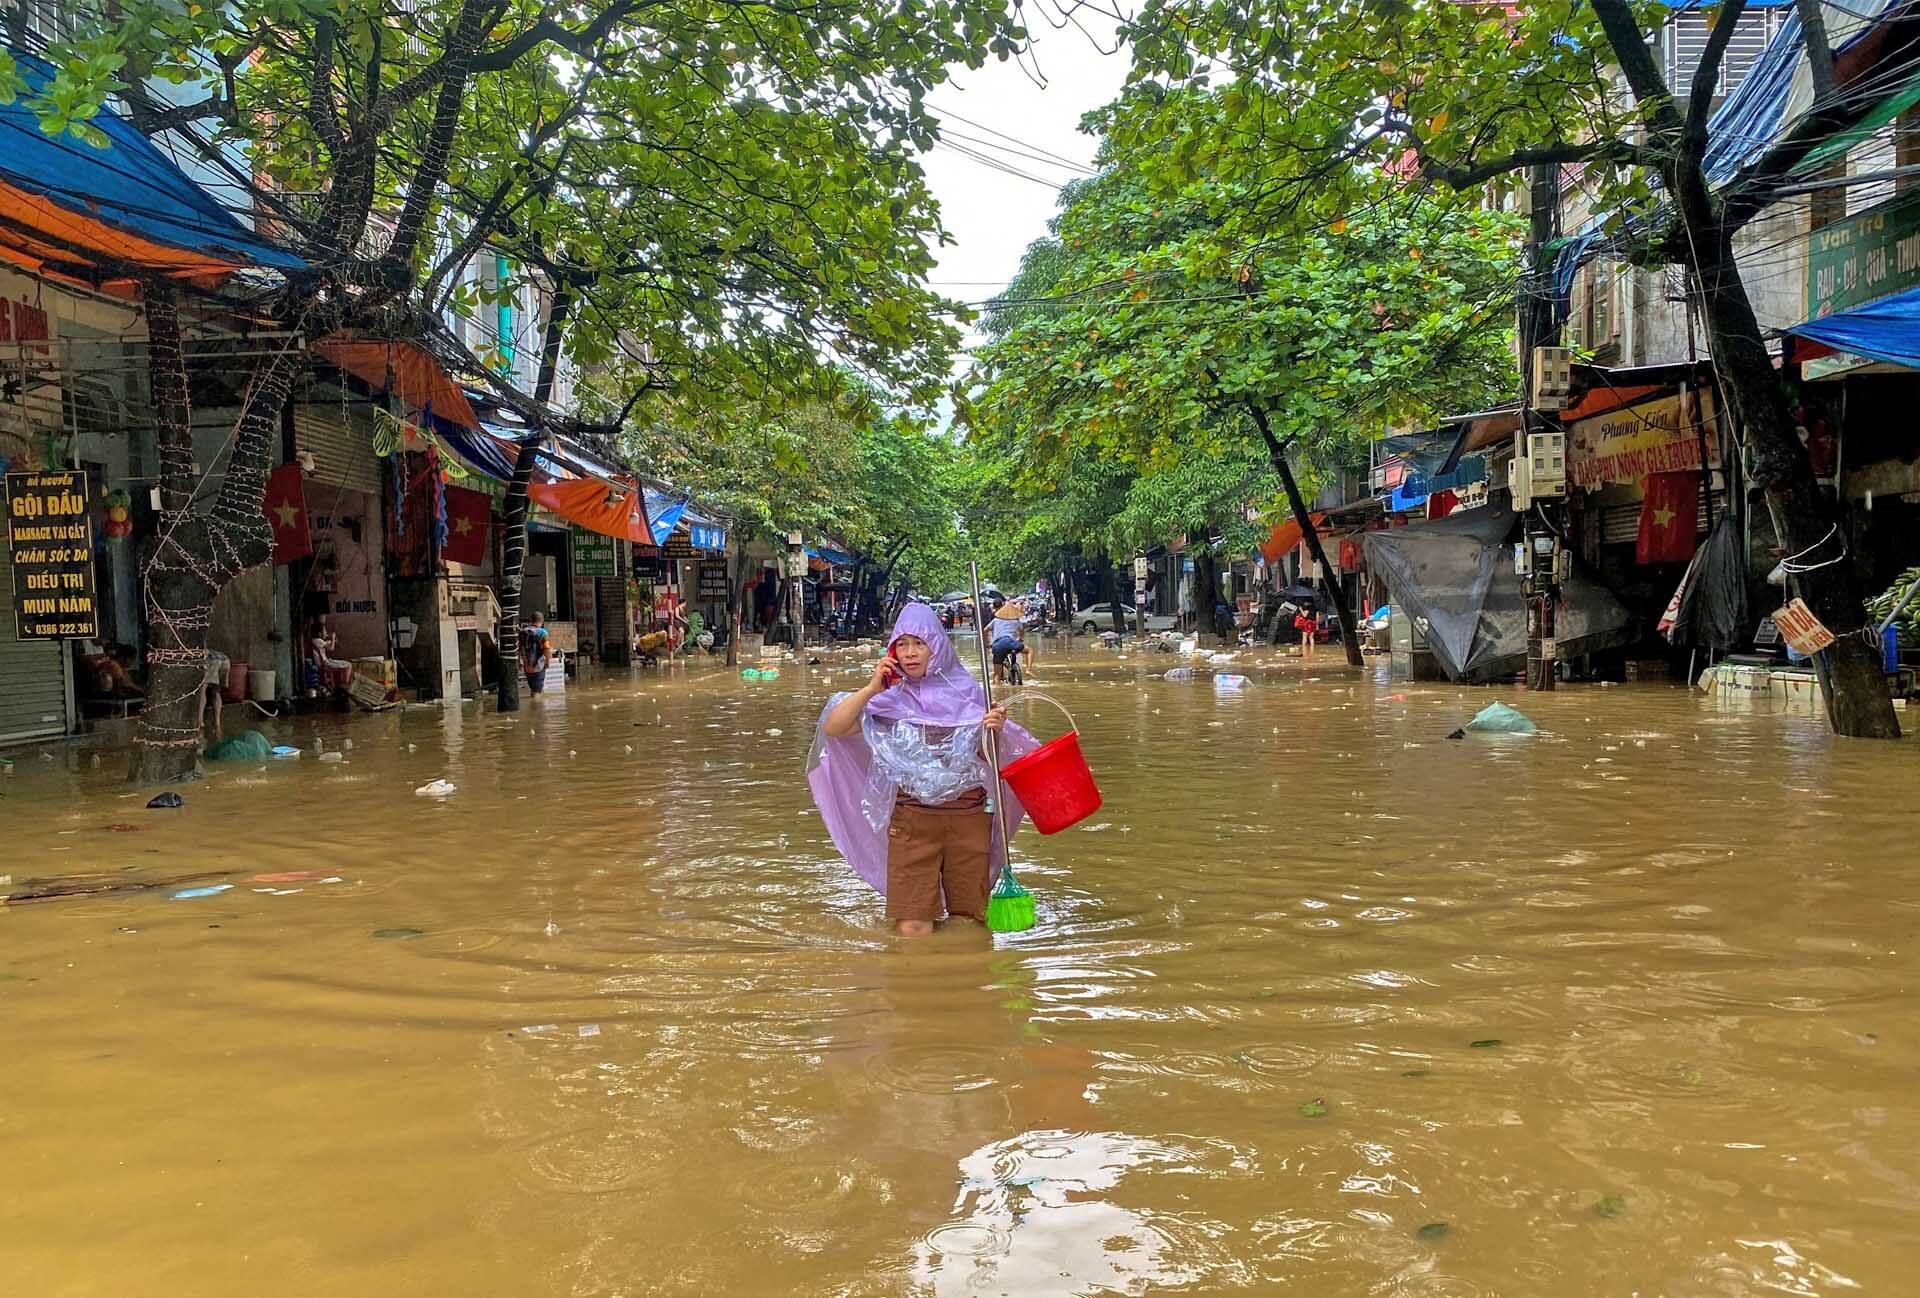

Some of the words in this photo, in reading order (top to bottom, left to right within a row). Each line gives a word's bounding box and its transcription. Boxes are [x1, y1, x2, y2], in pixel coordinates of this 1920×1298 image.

[1817, 265, 1835, 300] RAU
[12, 492, 43, 520] GỘI
[47, 488, 84, 515] ĐẦU
[14, 526, 51, 540] MASSAGE
[52, 525, 67, 539] VAI
[49, 545, 71, 562] SÓC
[73, 548, 88, 562] DA
[61, 573, 84, 590] TRỊ
[23, 598, 56, 616] MỤN
[58, 594, 92, 612] NÁM
[59, 623, 76, 633] 222
[78, 622, 93, 633] 361
